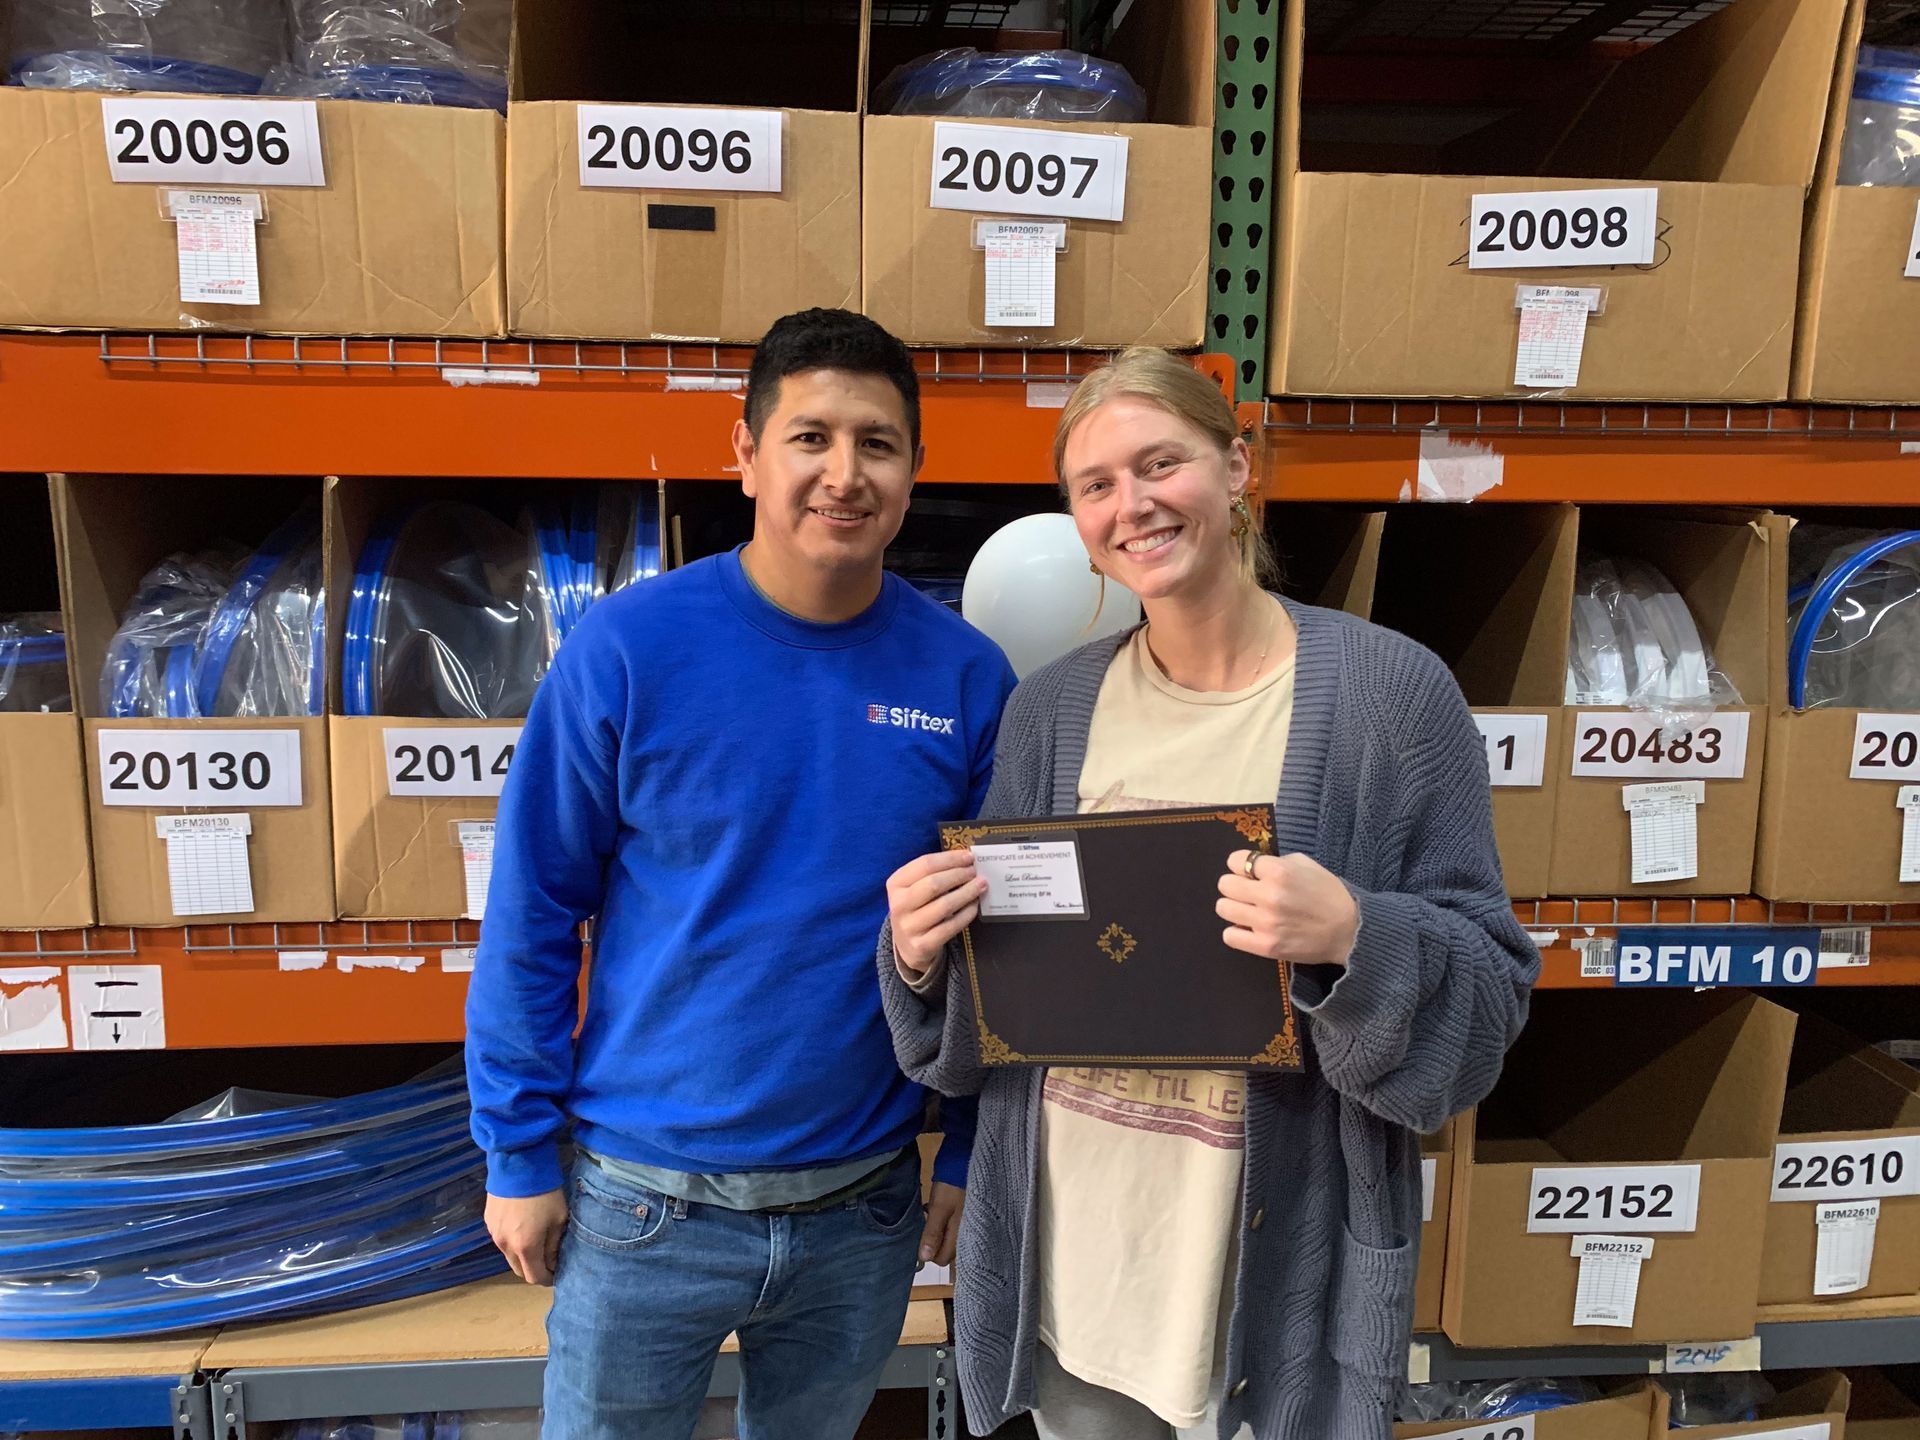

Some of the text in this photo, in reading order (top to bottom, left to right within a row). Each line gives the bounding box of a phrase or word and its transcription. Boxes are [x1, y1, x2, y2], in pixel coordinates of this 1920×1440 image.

[115, 119, 289, 165] 20096
[587, 125, 751, 174] 20096
[939, 146, 1098, 199] 20097
[189, 195, 242, 205] BFM20096
[998, 225, 1044, 234] BFM20097
[1477, 206, 1627, 252] 20098
[890, 707, 955, 734] Siftex
[1580, 727, 1722, 763] 20483
[109, 751, 271, 790] 20130
[174, 818, 229, 827] BFM20130
[1025, 852, 1071, 860] ACHIEVEMENT
[1619, 945, 1813, 983] BFM 10
[1778, 1151, 1903, 1189] 22610
[1535, 1184, 1673, 1219] 22152
[1824, 1207, 1876, 1219] BFM22610
[1585, 1243, 1643, 1253] BFM22152
